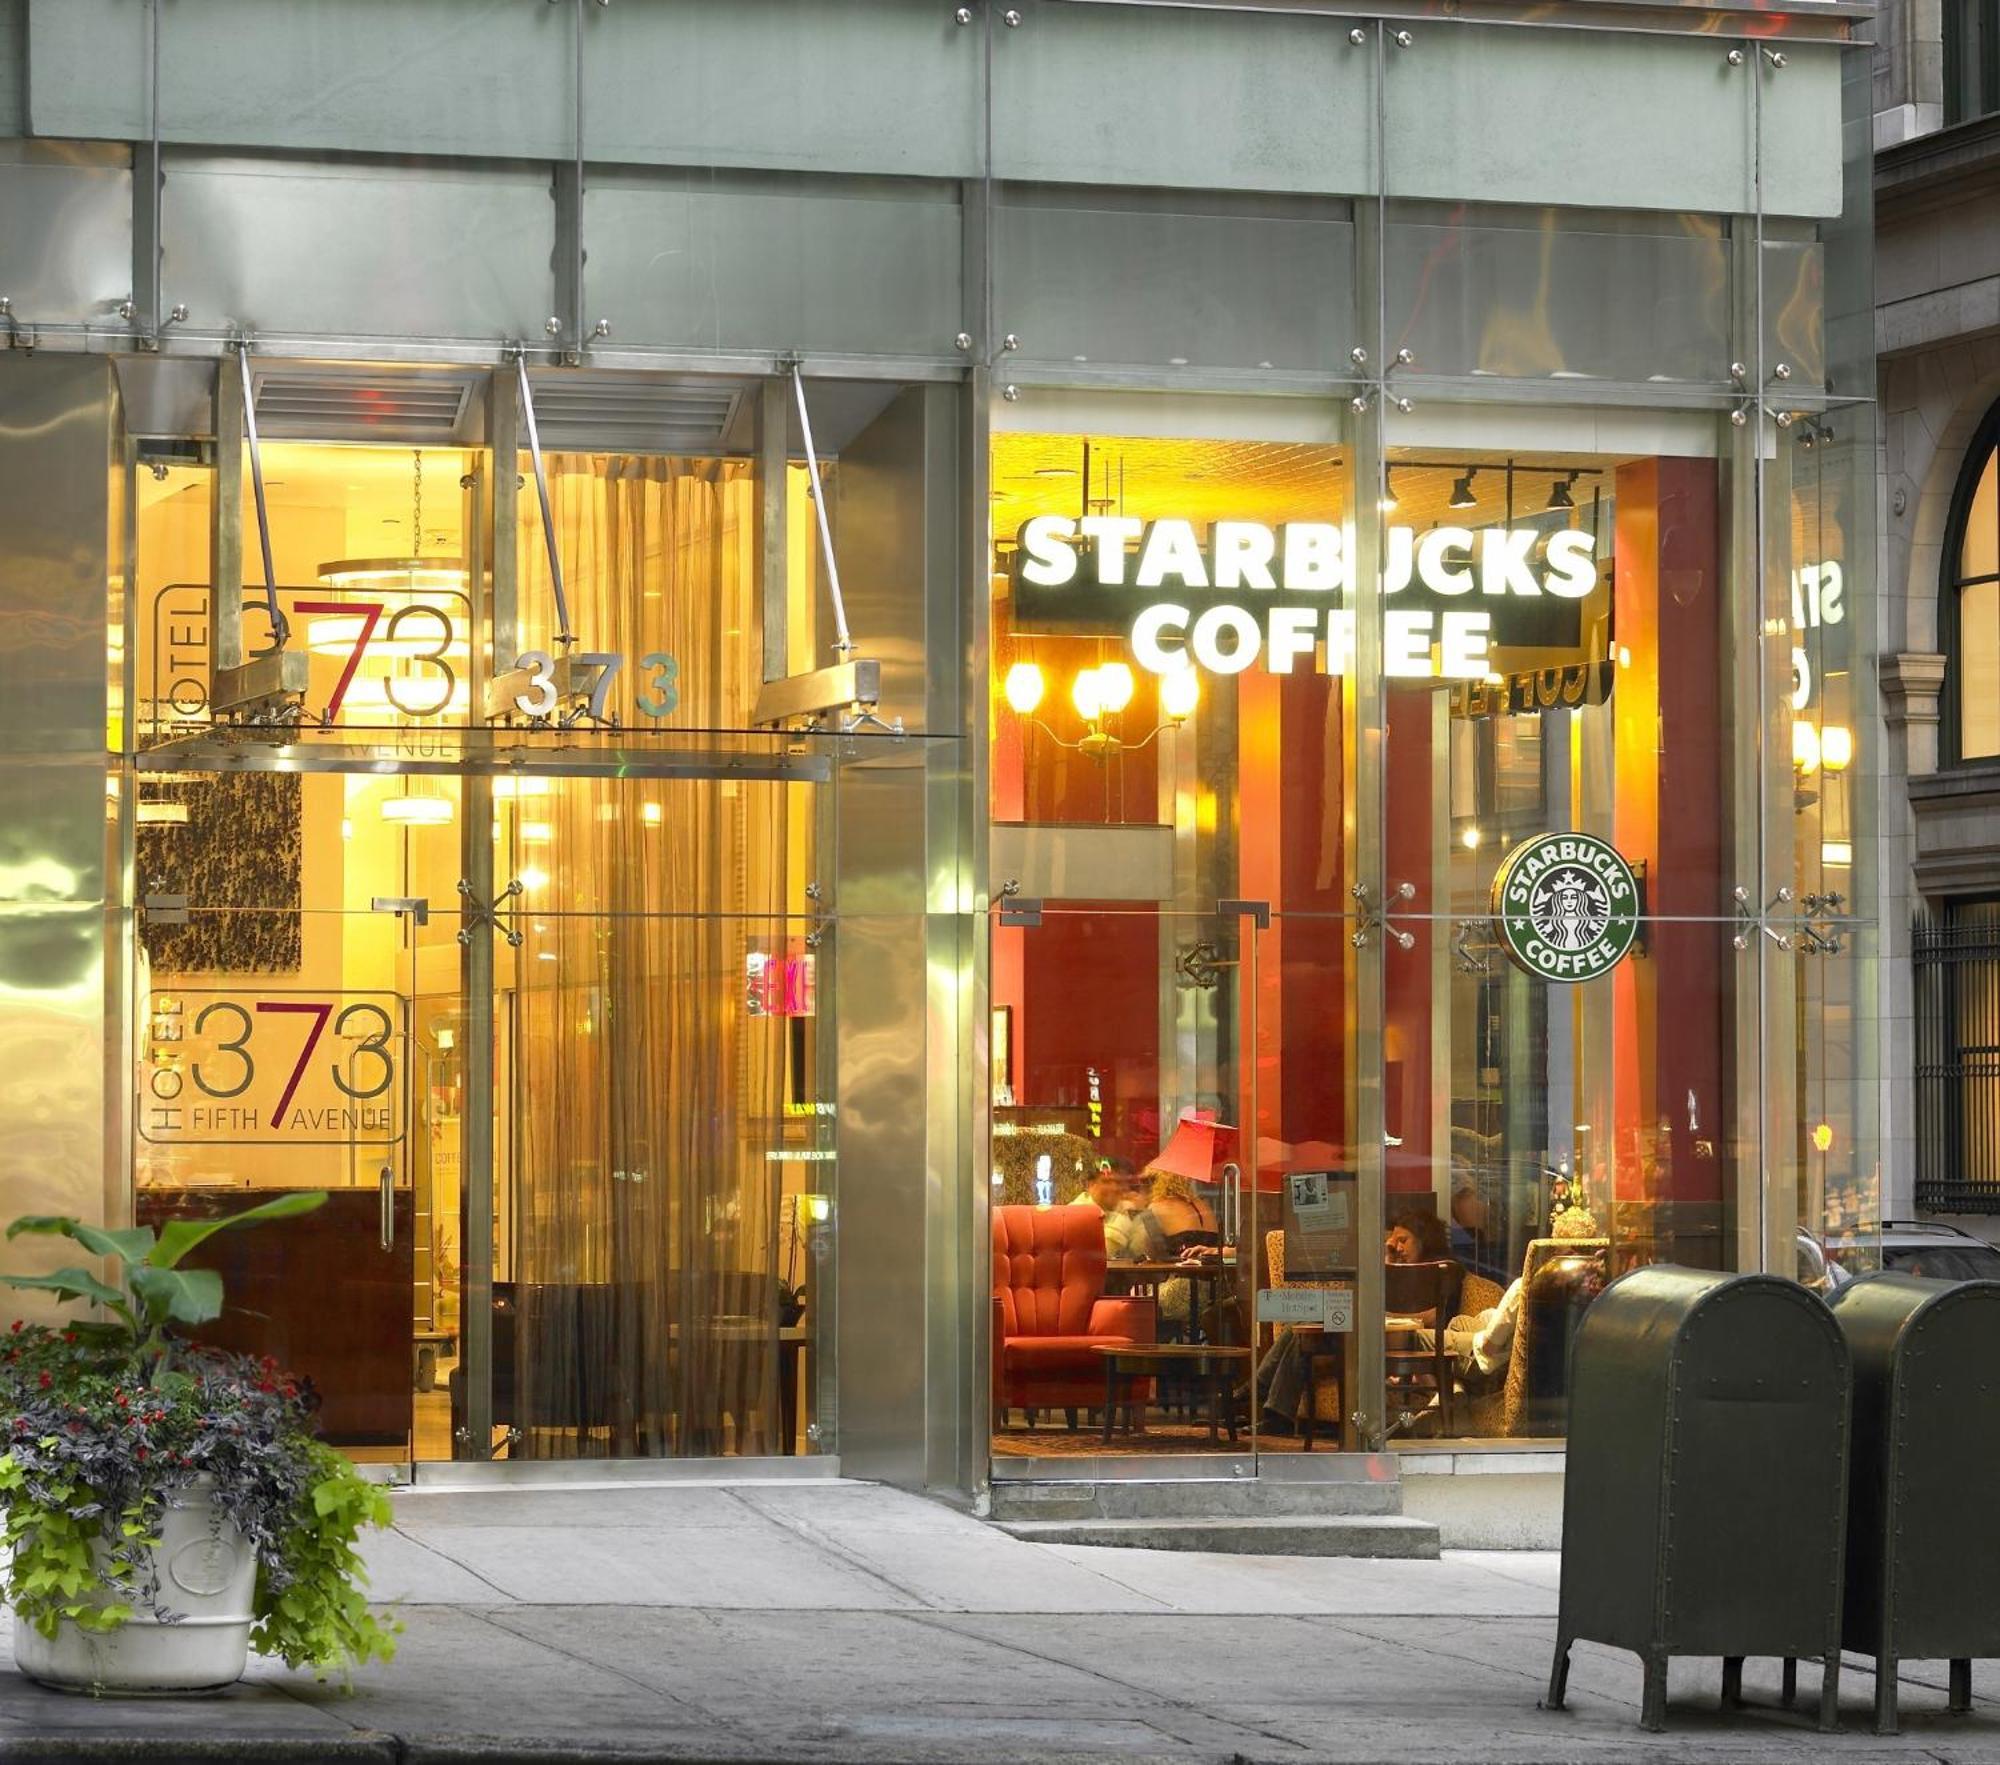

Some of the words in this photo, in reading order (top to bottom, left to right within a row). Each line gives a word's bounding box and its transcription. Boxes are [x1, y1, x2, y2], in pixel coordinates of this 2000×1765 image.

[514, 650, 678, 717] 373
[1509, 841, 1630, 904] STARBUCKS
[1525, 938, 1618, 974] COFFEE
[151, 1000, 183, 1130] HOTEL
[191, 1001, 394, 1129] 373
[193, 1108, 258, 1130] FIFTH
[290, 1108, 390, 1130] AVENUE
